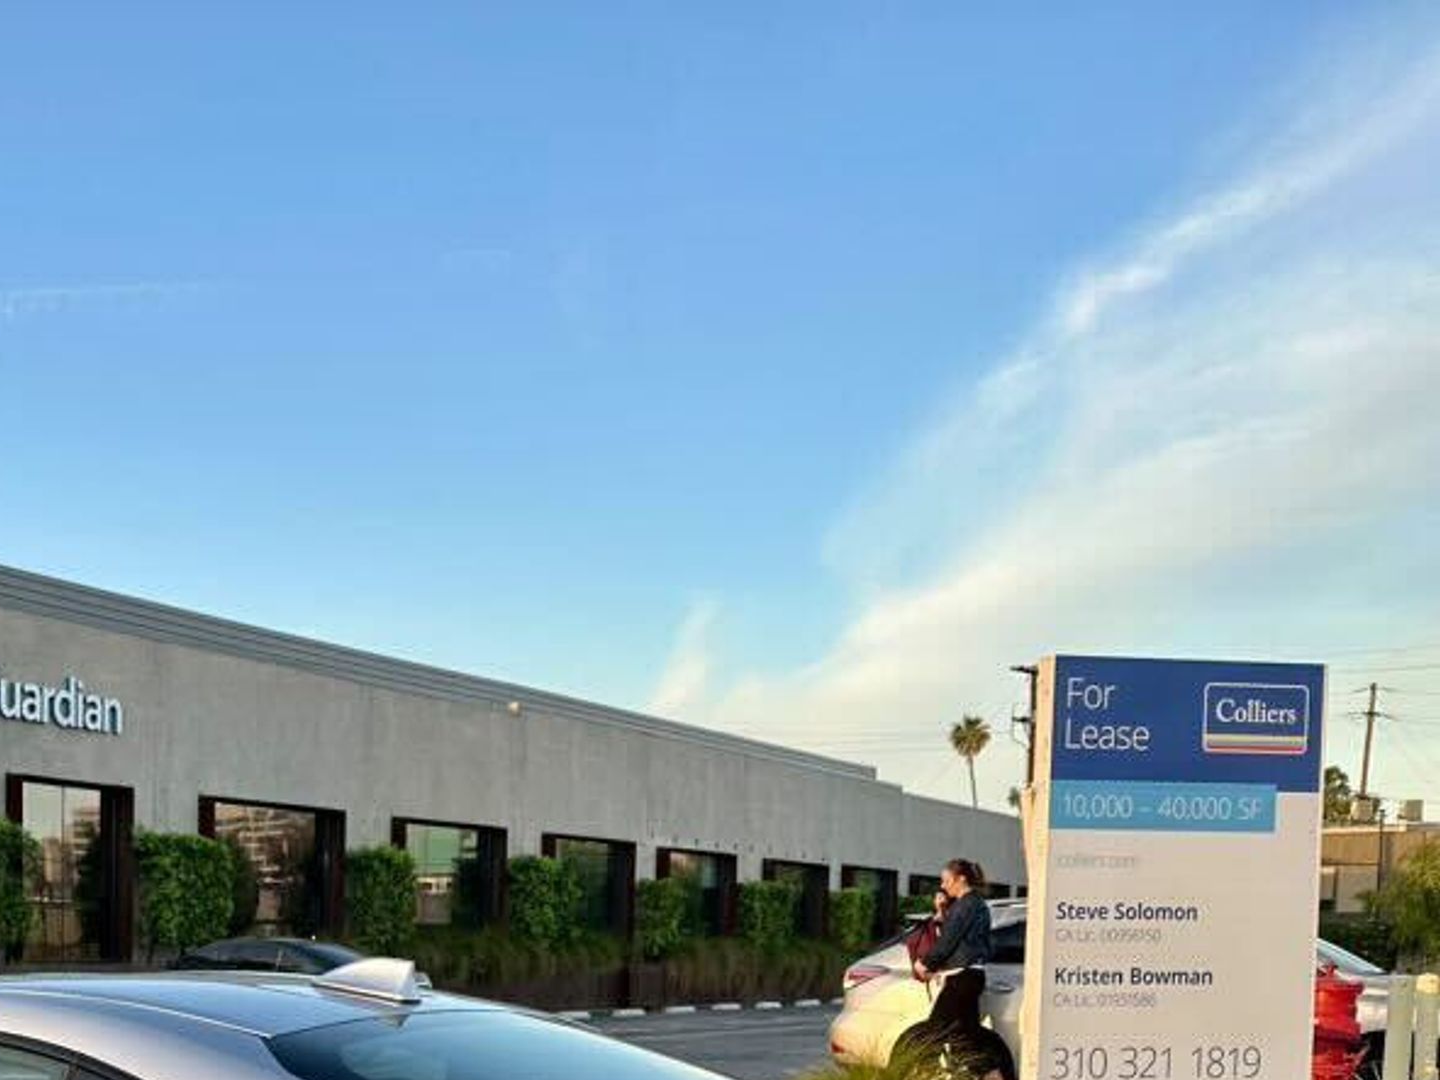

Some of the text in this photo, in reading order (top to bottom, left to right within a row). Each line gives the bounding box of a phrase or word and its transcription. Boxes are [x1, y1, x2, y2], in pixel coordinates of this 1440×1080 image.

[1067, 677, 1115, 710] For
[1215, 698, 1296, 724] Colliers
[1065, 718, 1150, 750] Lease
[1065, 794, 1132, 820] 10,000
[1238, 799, 1264, 821] SF
[1056, 902, 1199, 922] Steve Solomon
[1054, 967, 1213, 986] Kristen Bowman
[1050, 1047, 1262, 1080] 310 321 1819
